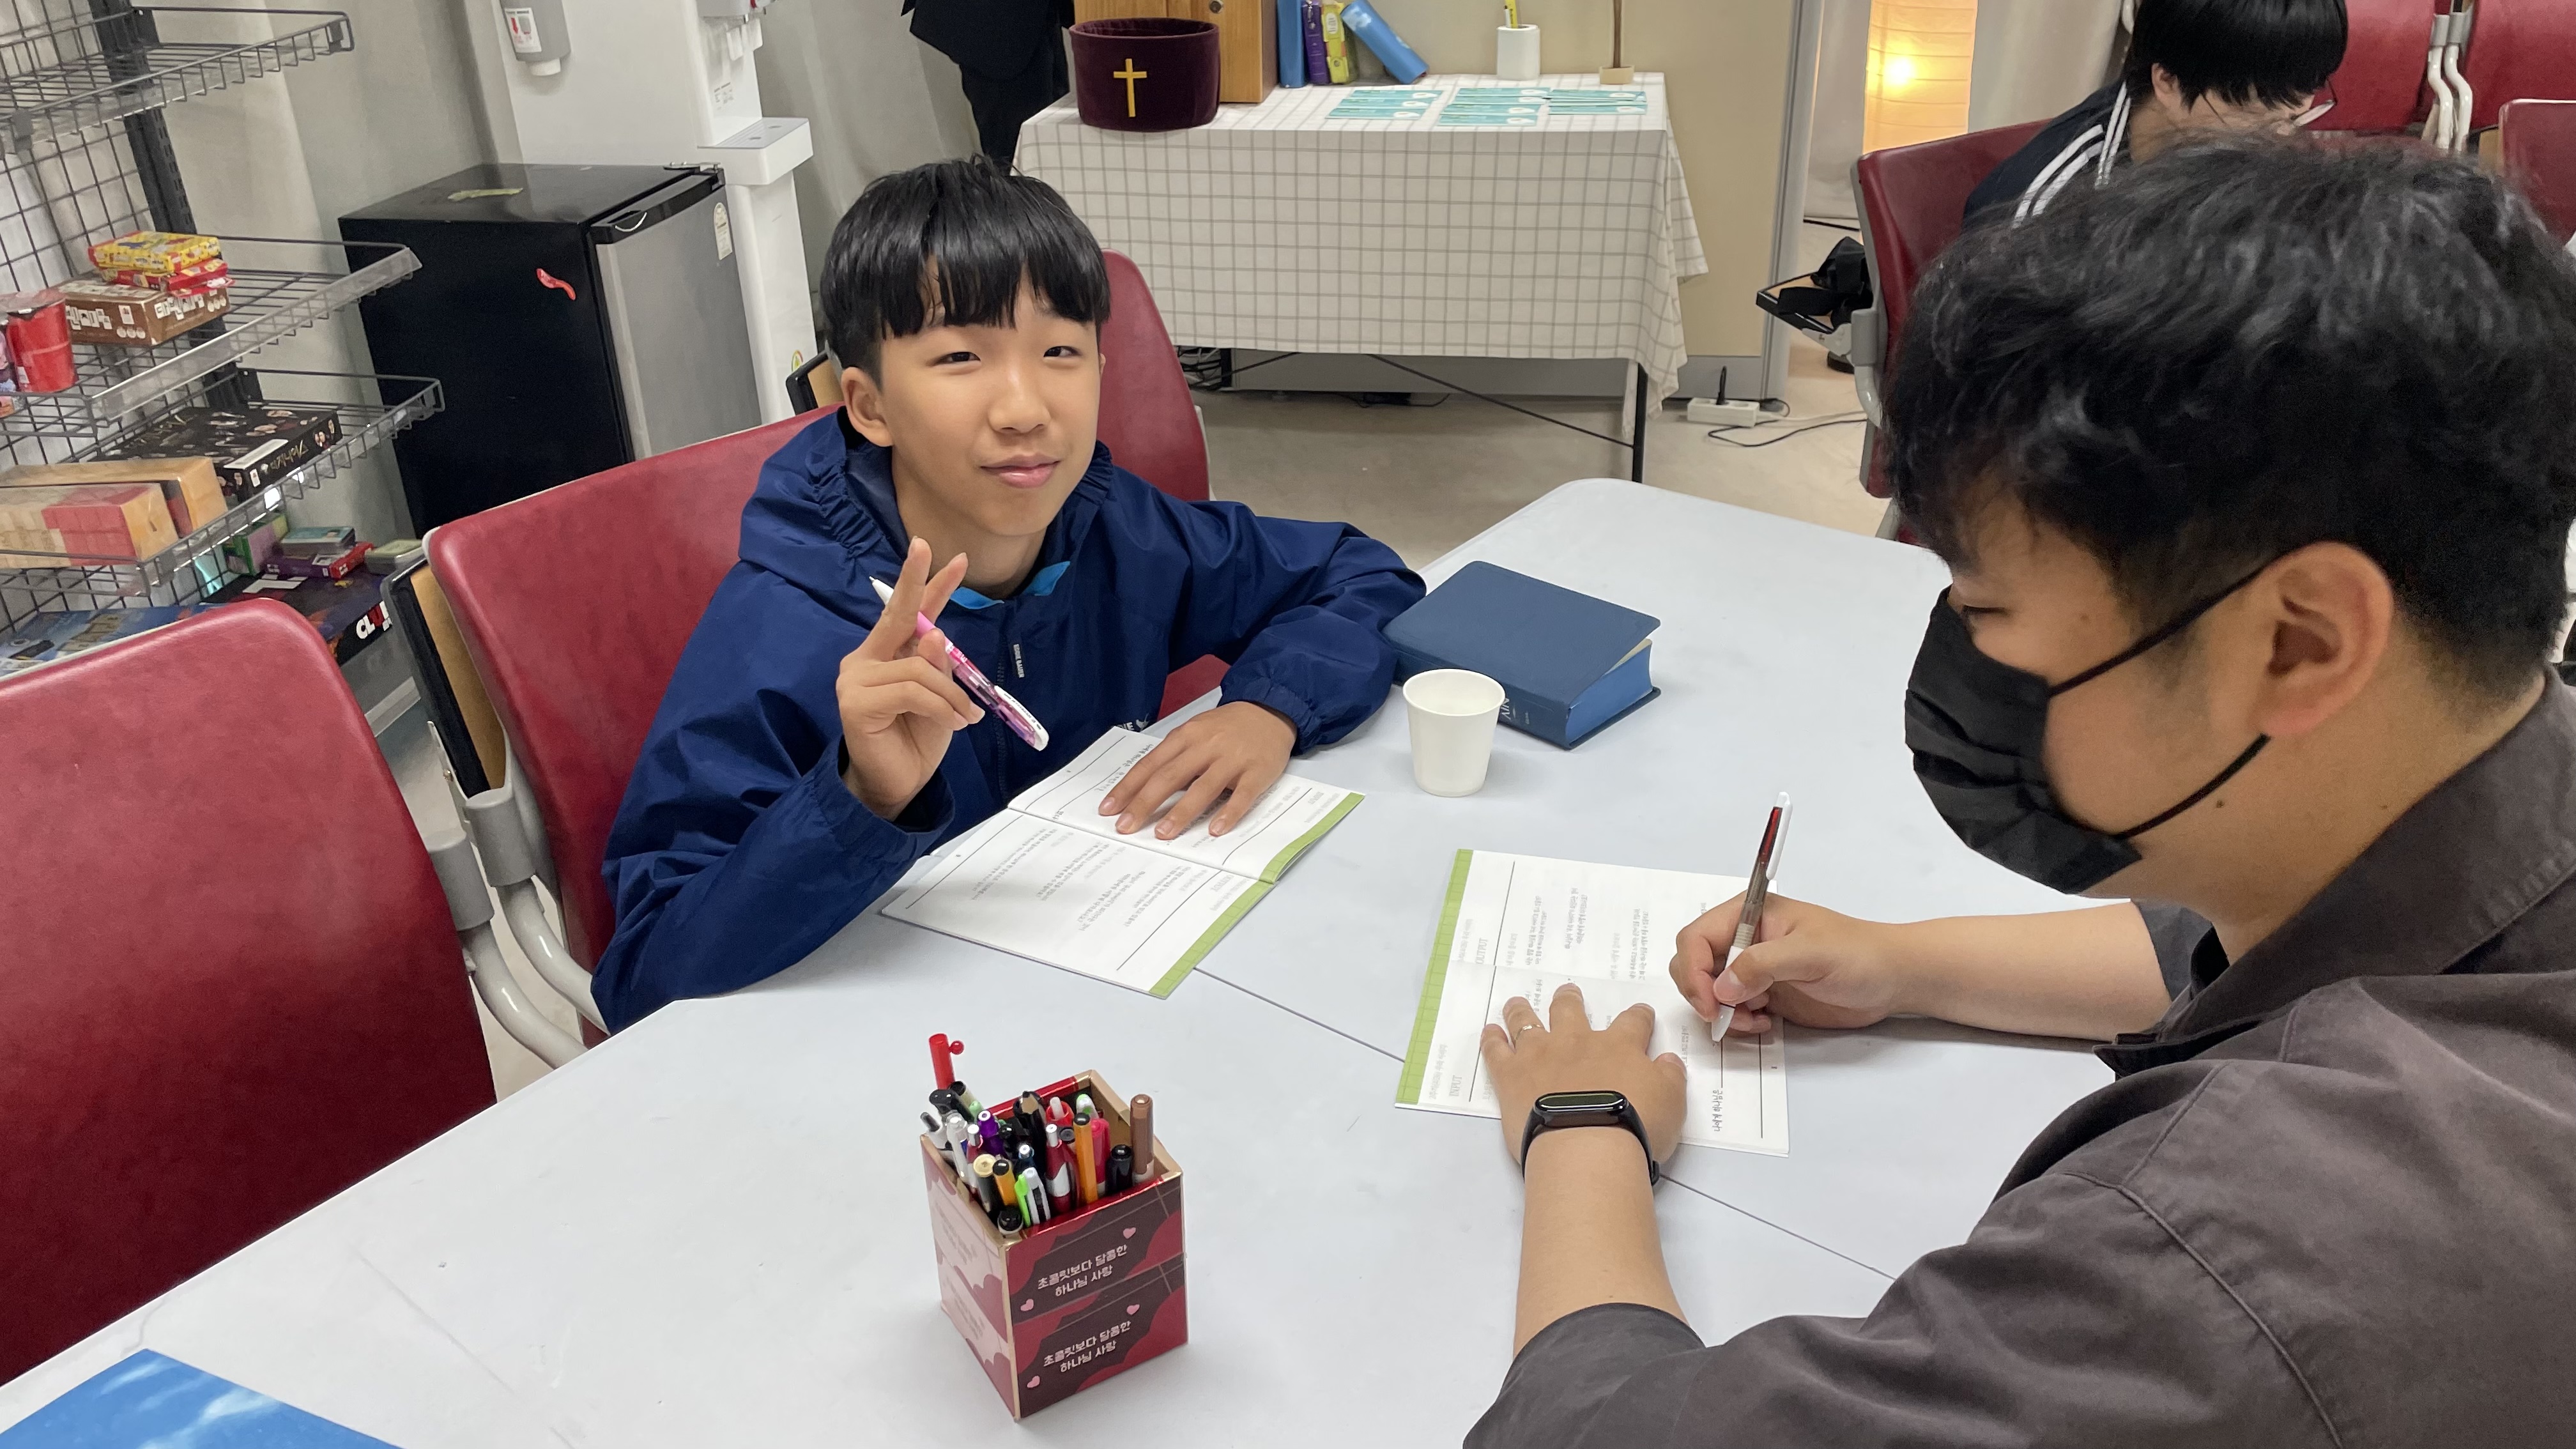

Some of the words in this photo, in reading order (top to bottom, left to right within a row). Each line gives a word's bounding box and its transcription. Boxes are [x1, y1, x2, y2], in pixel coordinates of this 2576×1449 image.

[356, 601, 388, 639] CLU
[1474, 937, 1488, 964] OUTPUT
[1448, 1074, 1462, 1097] INPUT
[1712, 1088, 1722, 1112] 하나님은
[1712, 1113, 1722, 1132] 나에게
[1038, 1259, 1093, 1290] 초콜릿보다
[1095, 1244, 1128, 1267] 달콤한
[1055, 1275, 1088, 1297] 하나님
[1091, 1264, 1114, 1282] 사랑
[1043, 1335, 1096, 1367] 초콜릿보다
[1100, 1320, 1131, 1343] 달콤한
[1060, 1351, 1092, 1373] 하나님
[1095, 1340, 1117, 1358] 사랑
